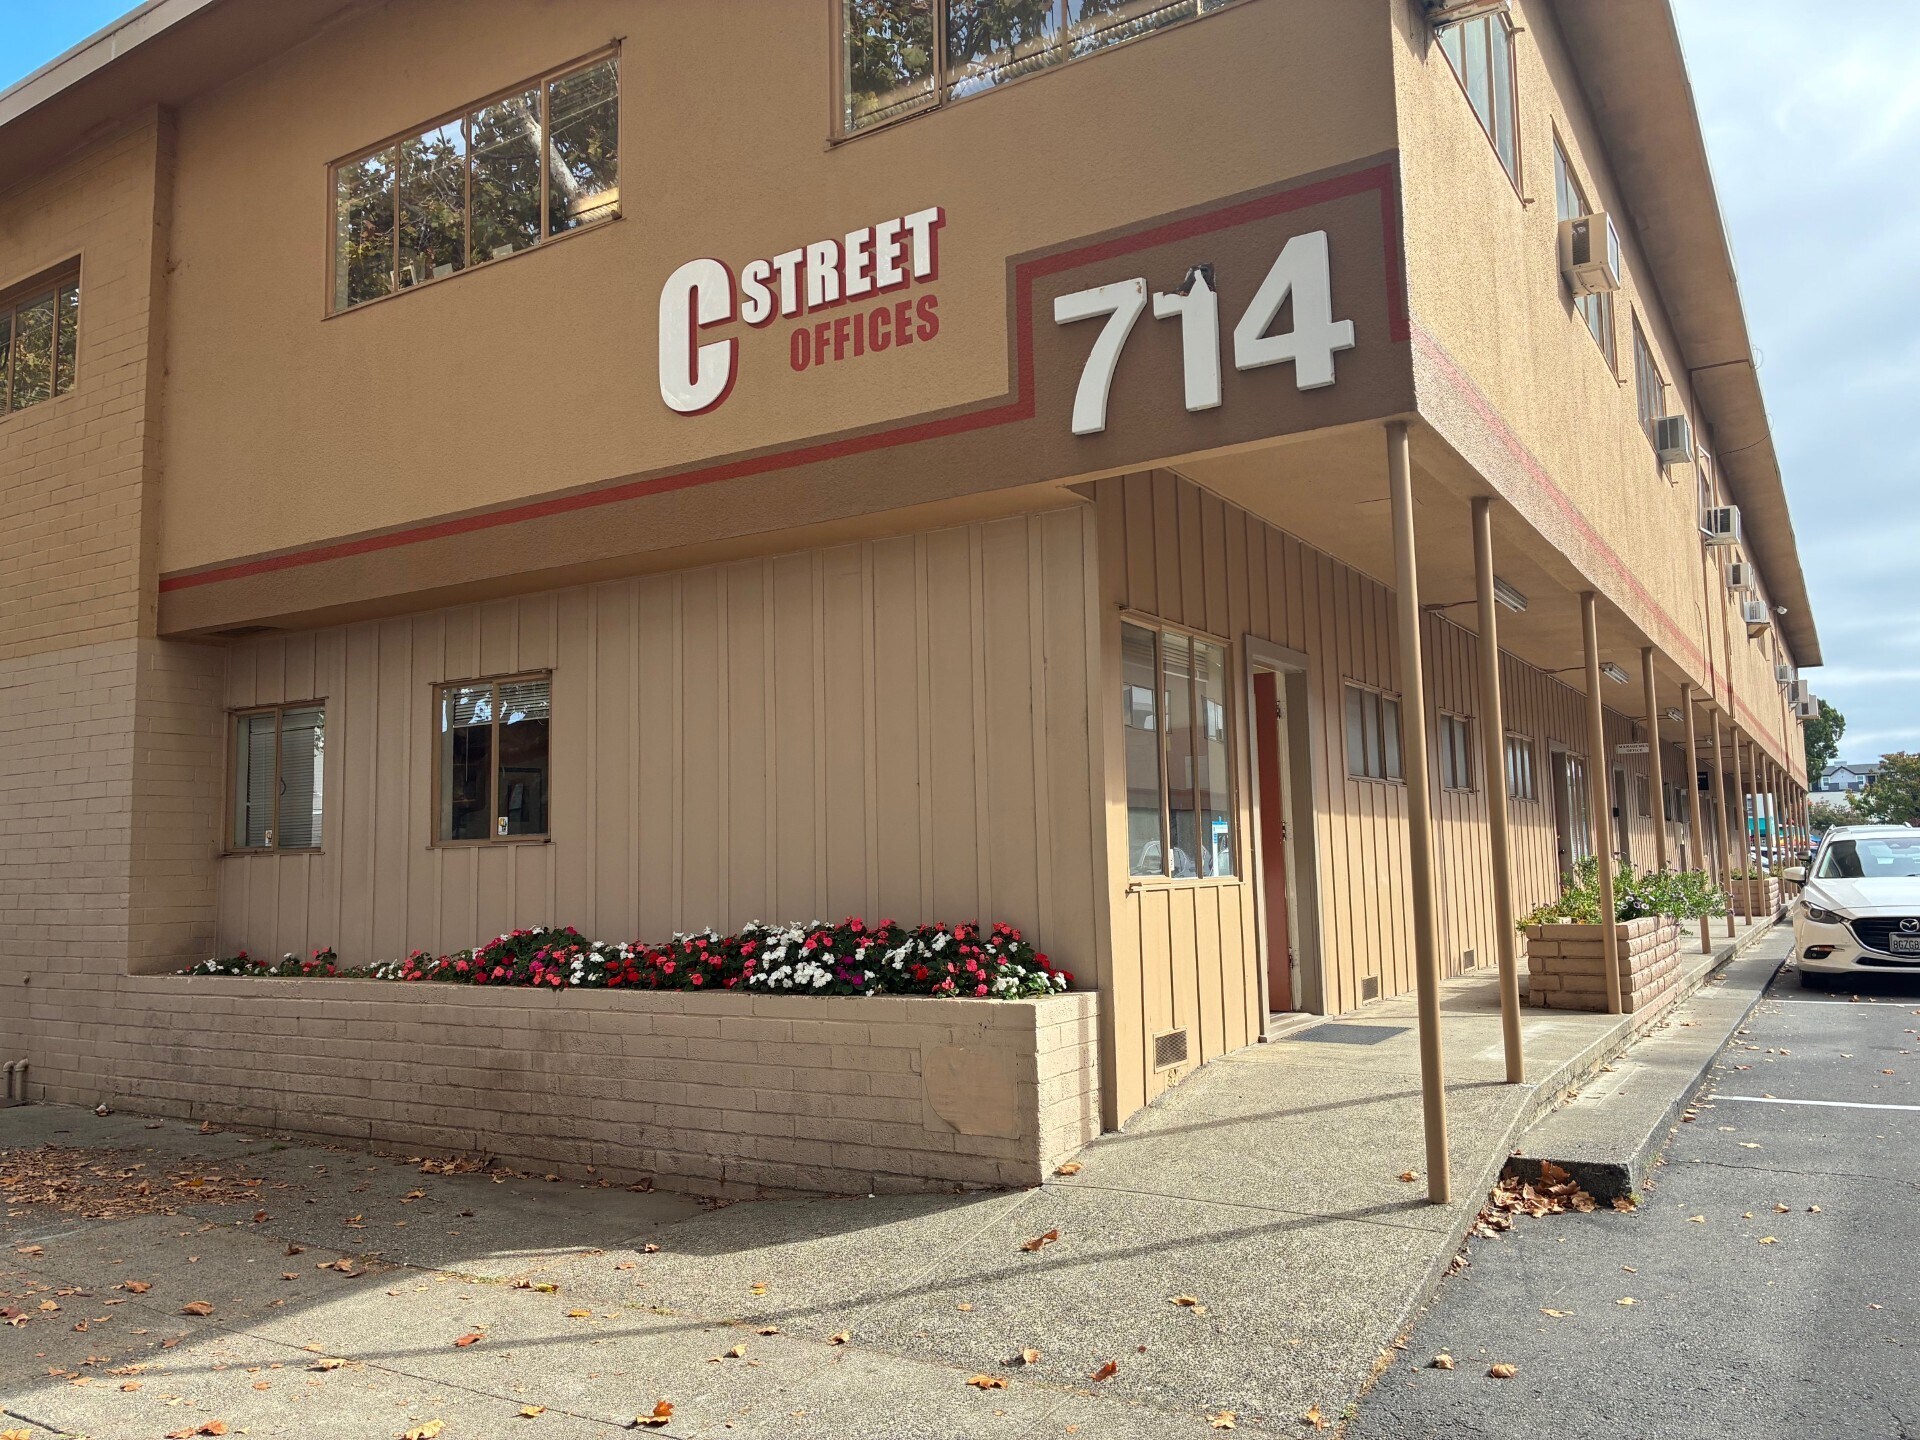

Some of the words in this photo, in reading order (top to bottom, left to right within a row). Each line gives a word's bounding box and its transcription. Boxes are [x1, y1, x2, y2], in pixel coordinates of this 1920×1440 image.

[659, 257, 739, 417] C
[741, 206, 946, 329] STREET
[790, 294, 940, 372] OFFICES
[1054, 230, 1356, 436] 714
